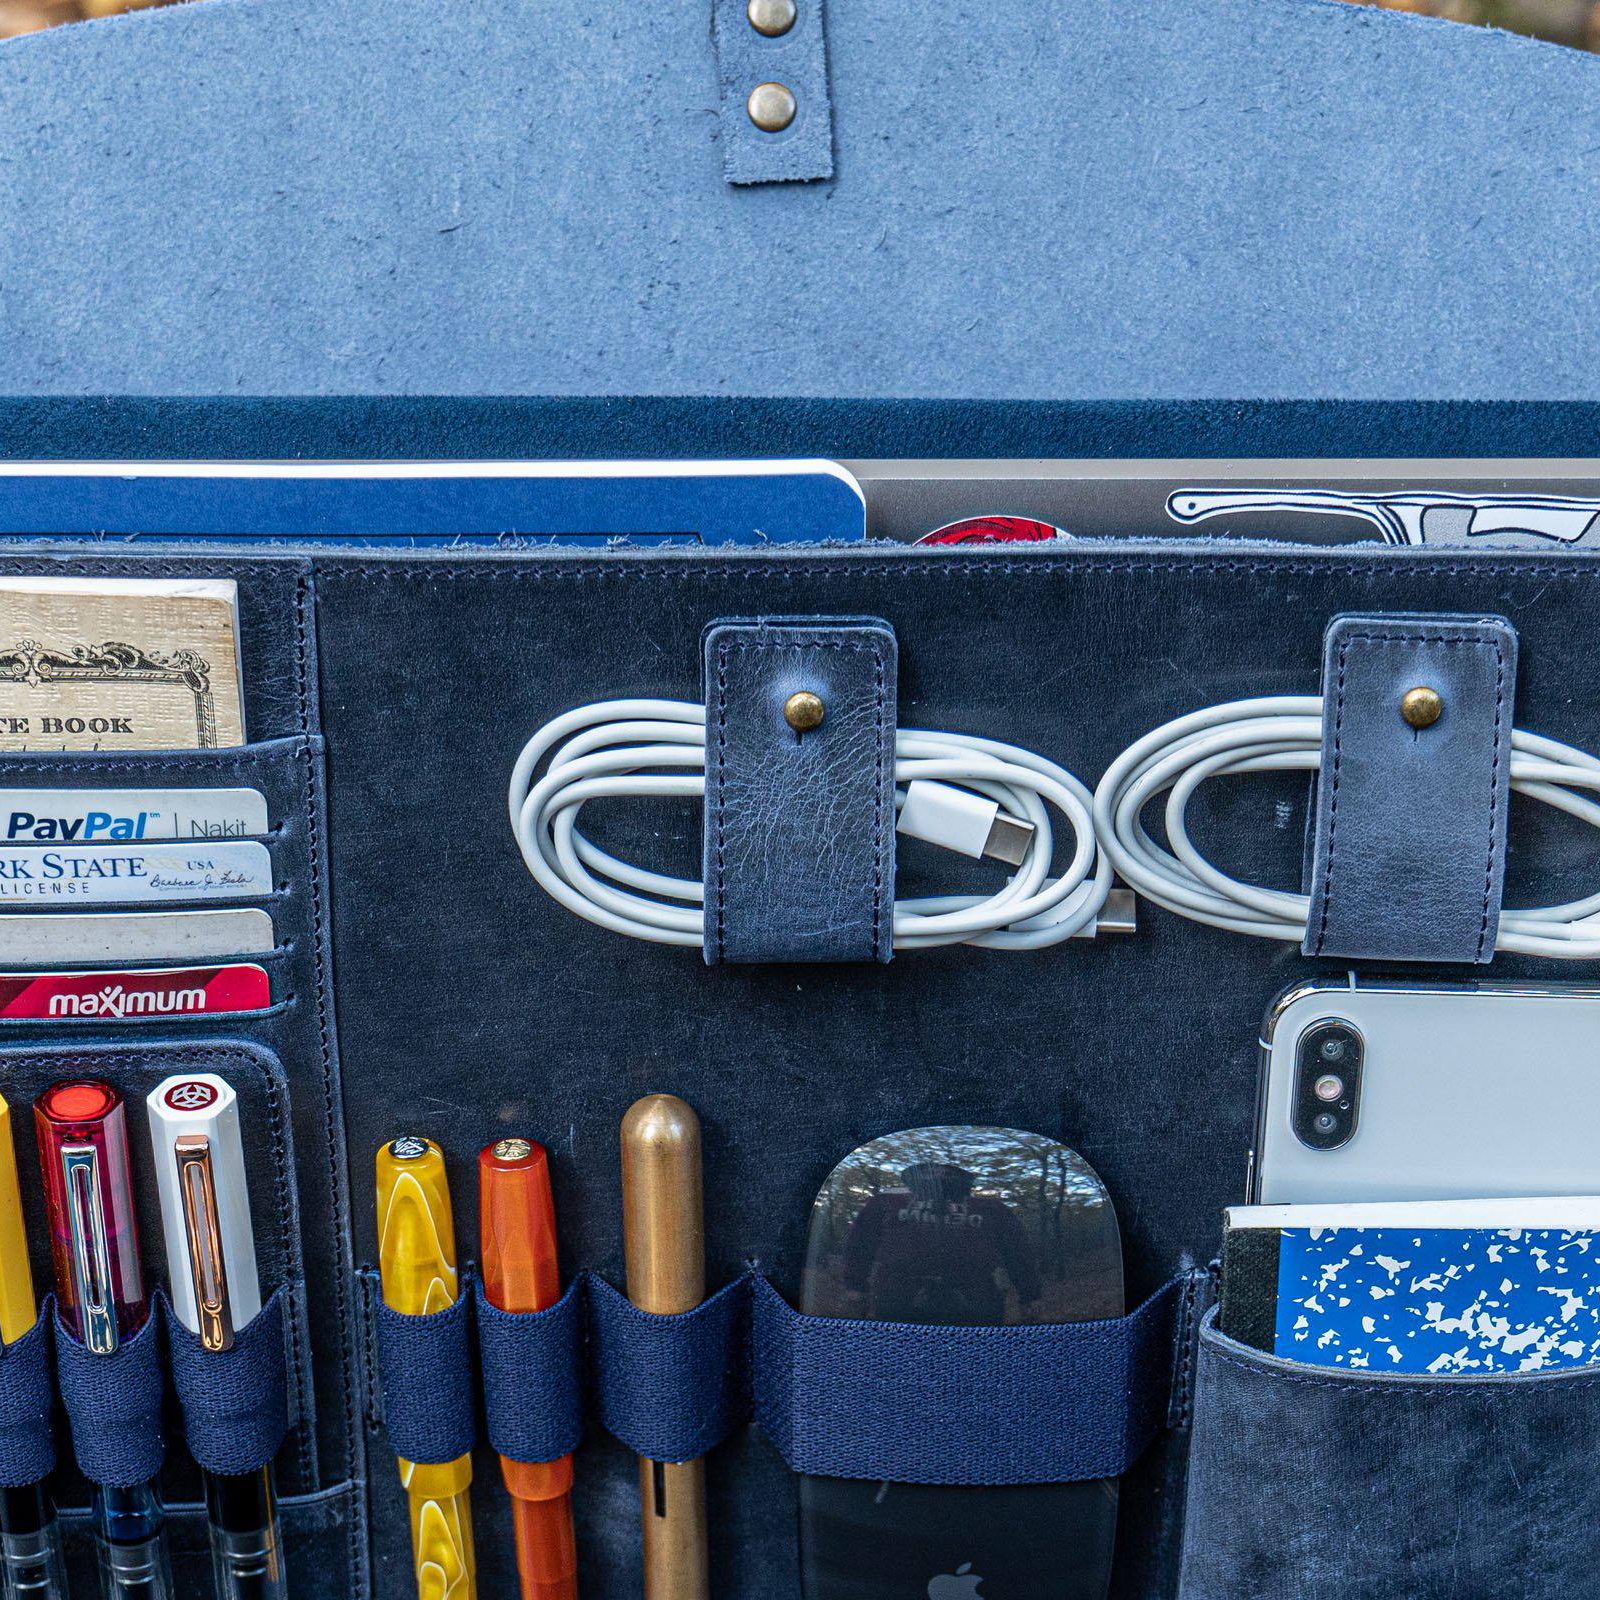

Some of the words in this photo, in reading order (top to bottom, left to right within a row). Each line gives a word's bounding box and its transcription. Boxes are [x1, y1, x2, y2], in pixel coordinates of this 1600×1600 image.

[41, 717, 135, 734] BOOK
[7, 811, 148, 840] PayPal
[191, 818, 247, 838] Nakit
[42, 853, 148, 879] STATE
[187, 860, 215, 870] USA
[0, 882, 91, 895] LICENSE
